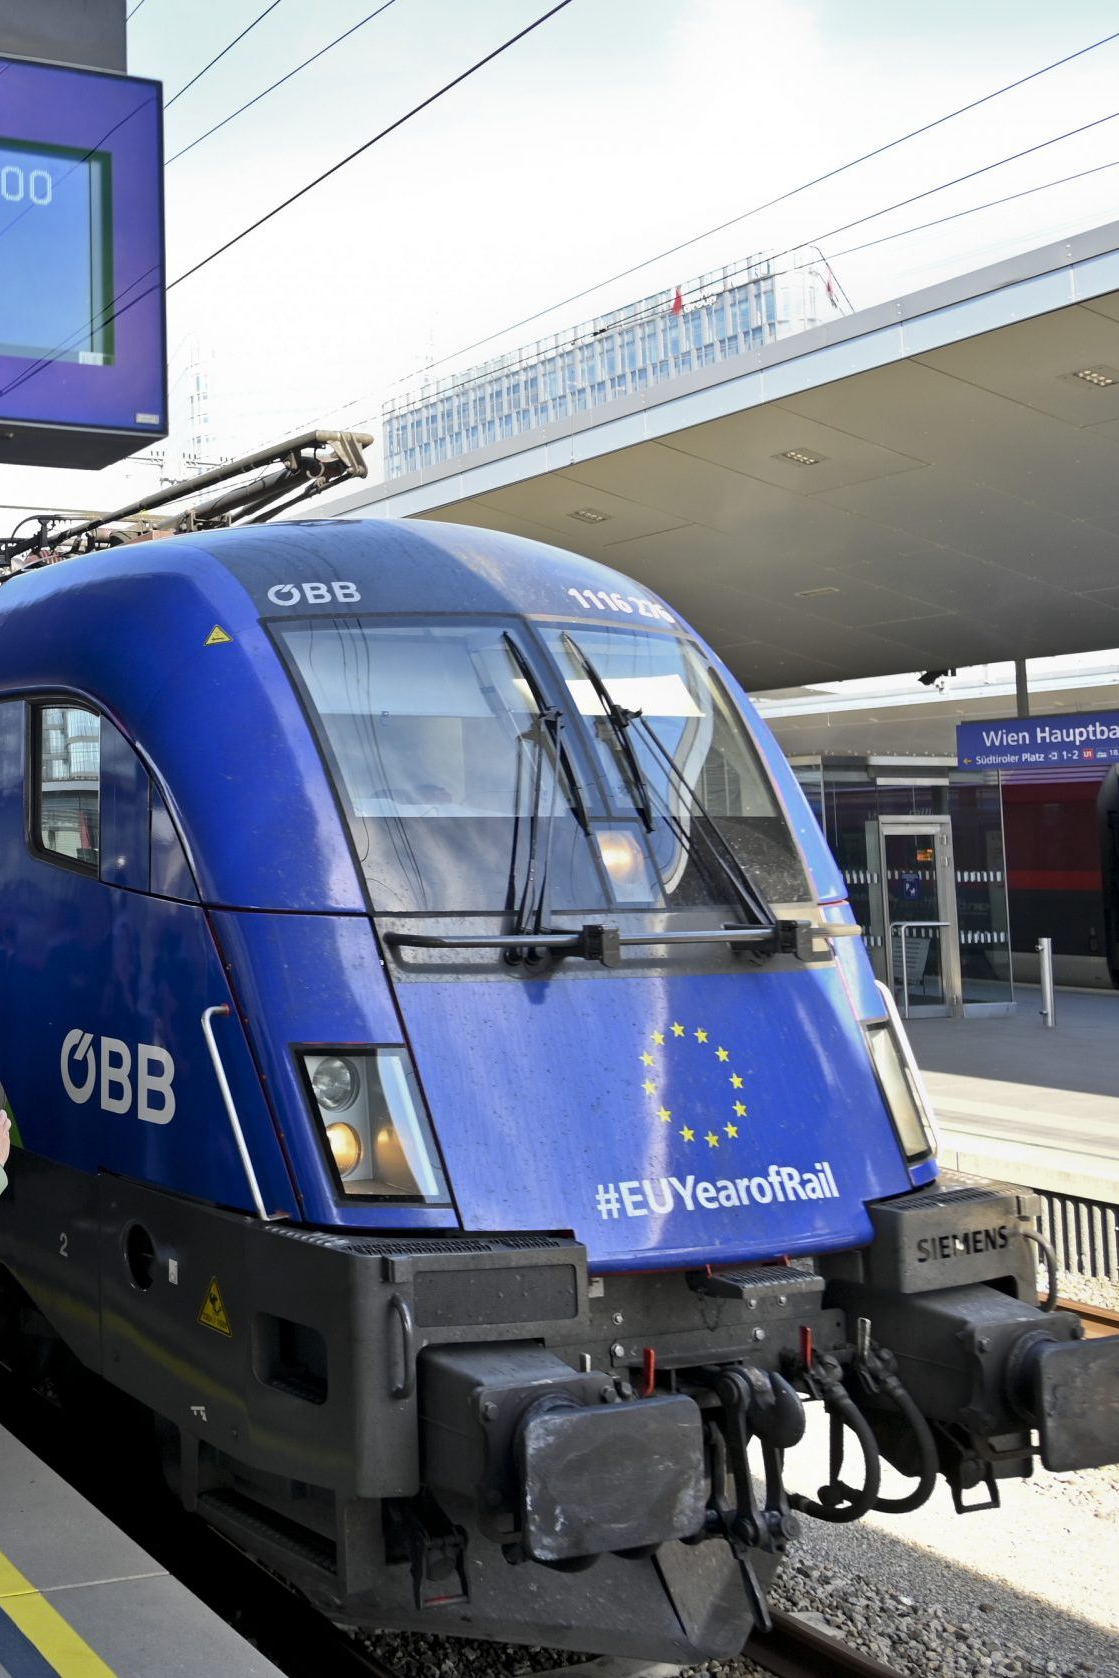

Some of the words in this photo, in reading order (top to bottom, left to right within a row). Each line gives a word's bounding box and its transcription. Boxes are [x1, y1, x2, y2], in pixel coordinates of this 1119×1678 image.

[267, 581, 361, 606] ÖBB
[567, 587, 634, 614] 1116
[982, 729, 1030, 747] Wien
[975, 755, 1019, 765] Südtiroler
[1021, 752, 1045, 762] Platz
[60, 1028, 176, 1125] ÖBB
[595, 1161, 840, 1220] #EUYearofRail
[59, 1232, 69, 1257] 2
[916, 1225, 1009, 1263] SIEMENS
